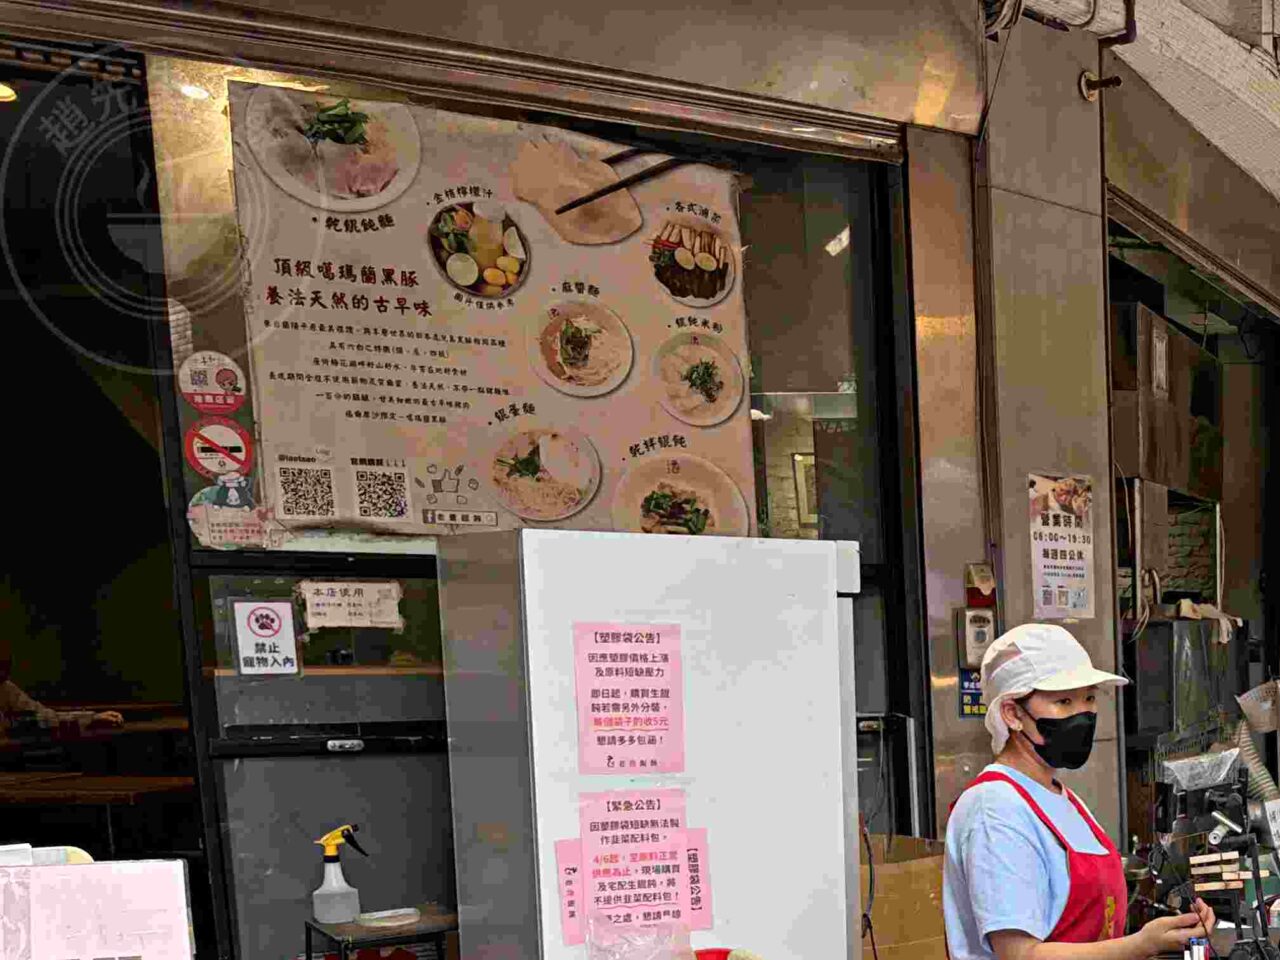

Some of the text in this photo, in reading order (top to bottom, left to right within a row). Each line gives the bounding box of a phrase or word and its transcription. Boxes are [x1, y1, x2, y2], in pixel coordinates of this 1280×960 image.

[265, 285, 434, 318] 養法天然的古早味
[254, 642, 281, 655] 禁止
[606, 798, 662, 813] 【緊急公告】
